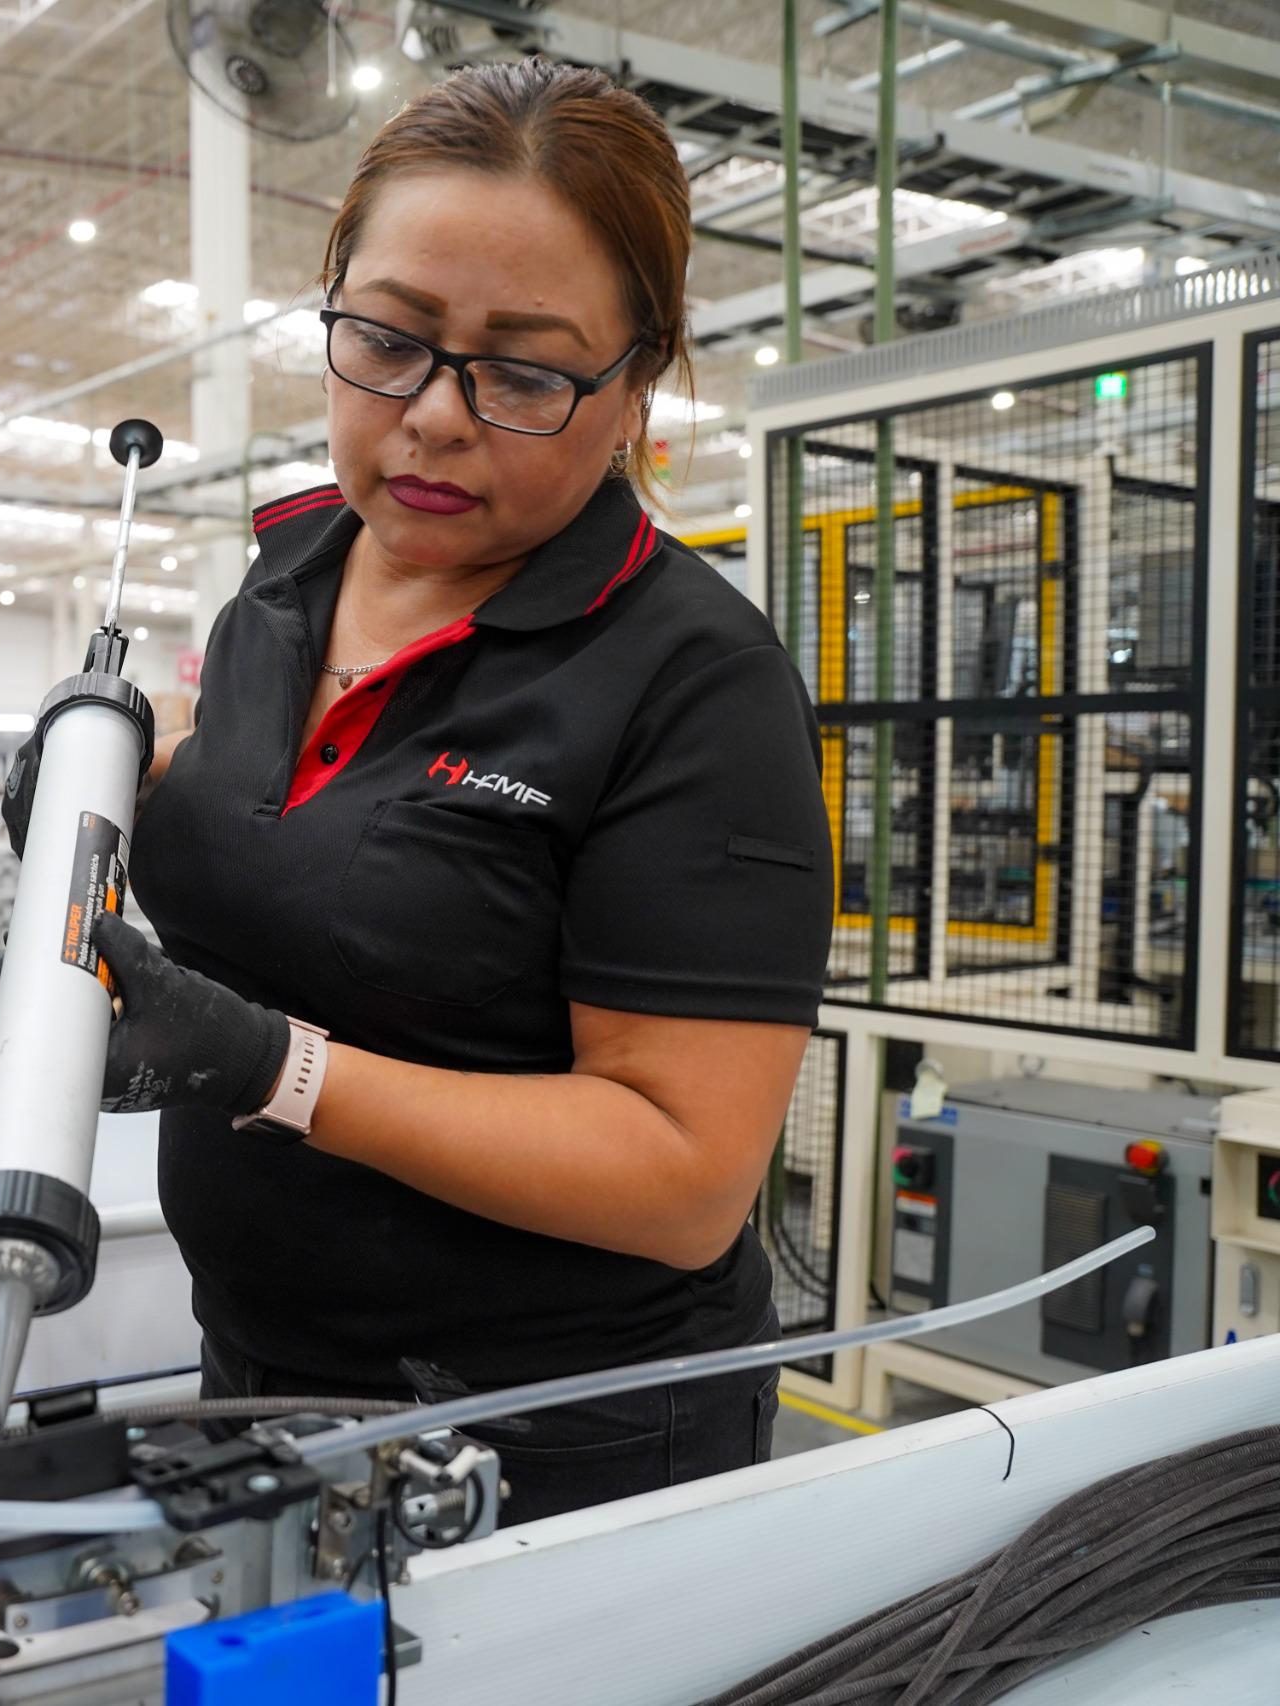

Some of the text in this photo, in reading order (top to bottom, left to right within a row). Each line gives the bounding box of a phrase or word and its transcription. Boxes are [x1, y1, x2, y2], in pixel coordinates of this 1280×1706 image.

[89, 853, 100, 884] salchicha
[86, 882, 97, 897] tipo
[66, 903, 81, 946] TRUPER
[78, 942, 89, 967] Pistola
